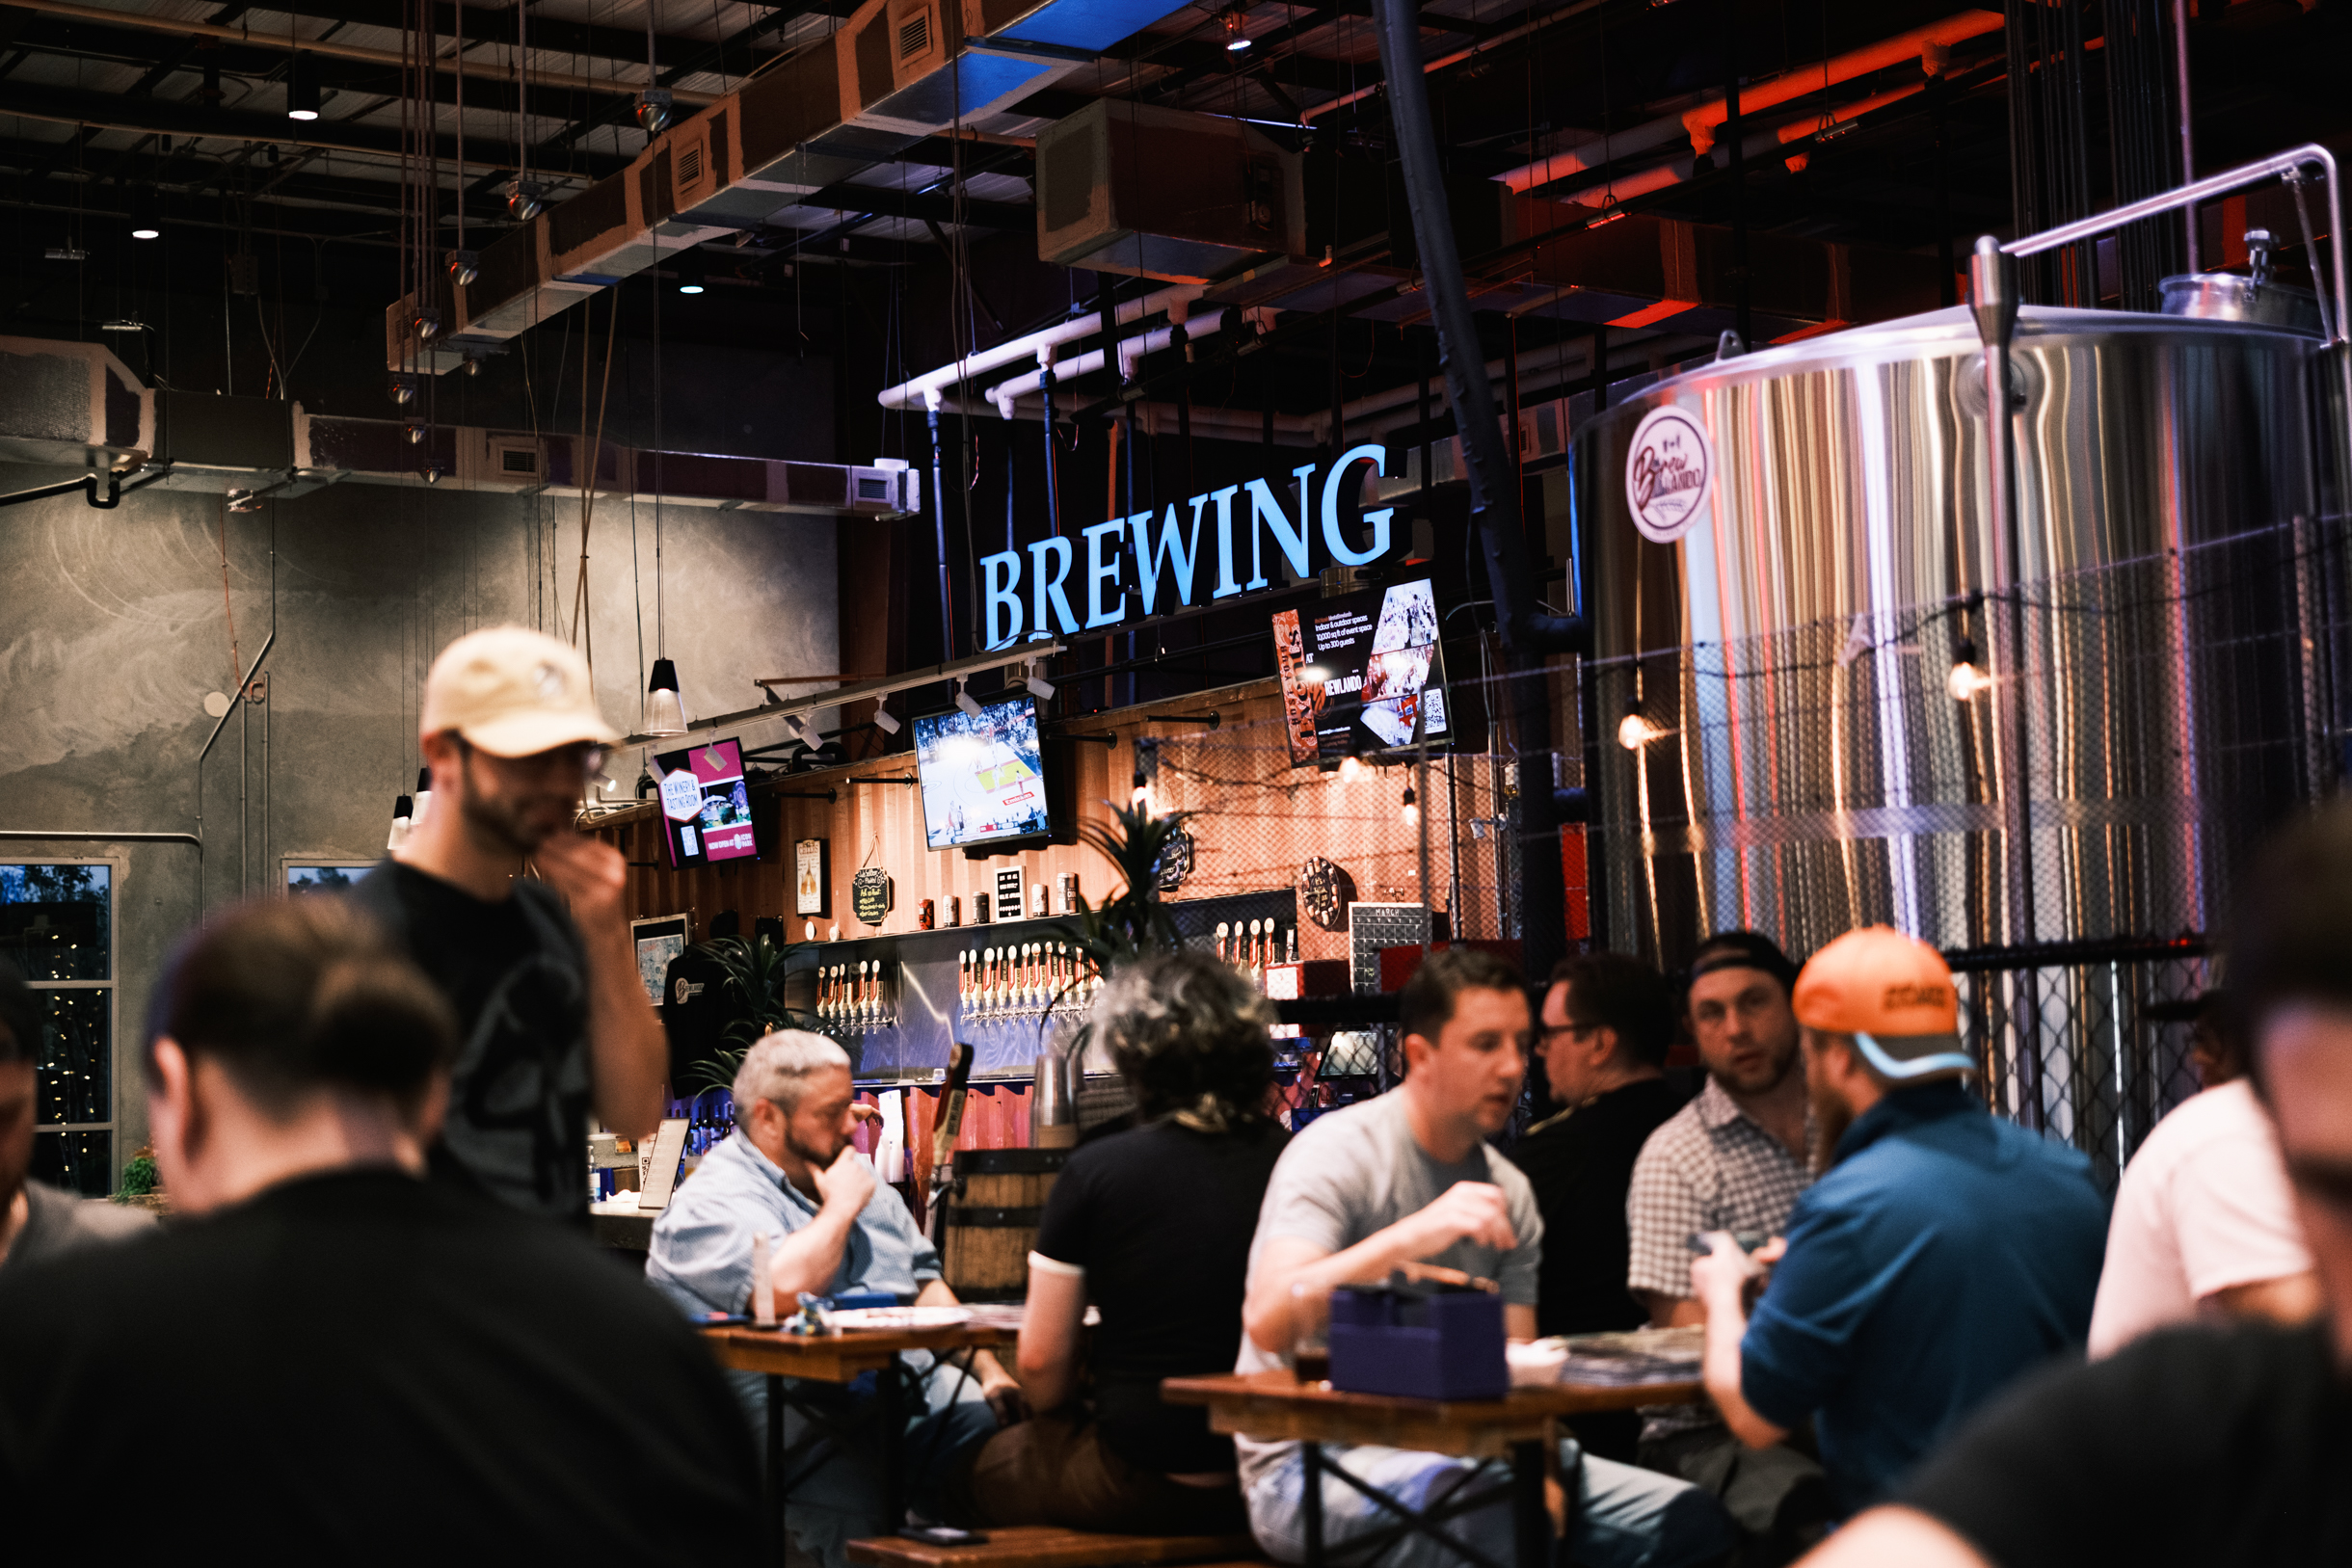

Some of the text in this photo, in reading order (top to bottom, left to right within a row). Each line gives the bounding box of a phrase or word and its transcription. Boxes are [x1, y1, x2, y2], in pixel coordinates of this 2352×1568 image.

[1633, 446, 1688, 512] Brew
[979, 444, 1394, 652] BREWING
[1315, 623, 1330, 632] Indoor
[1334, 618, 1351, 627] outdoor
[1352, 615, 1368, 625] spaces
[1316, 631, 1331, 642] 10,000
[1331, 631, 1337, 640] sq
[1346, 626, 1359, 635] event
[1359, 624, 1373, 633] space
[1318, 643, 1325, 651] Up
[1330, 640, 1339, 649] 300
[1339, 637, 1355, 649] guests
[1305, 652, 1314, 664] AT
[1280, 645, 1300, 726] HOST YOUR
[664, 779, 696, 796] THE WINERY &
[666, 793, 700, 811] TASTING ROOM
[708, 841, 719, 850] NOW
[718, 839, 730, 848] OPEN
[740, 833, 752, 841] ICON
[741, 839, 753, 848] PARK
[1376, 908, 1400, 917] MARCH
